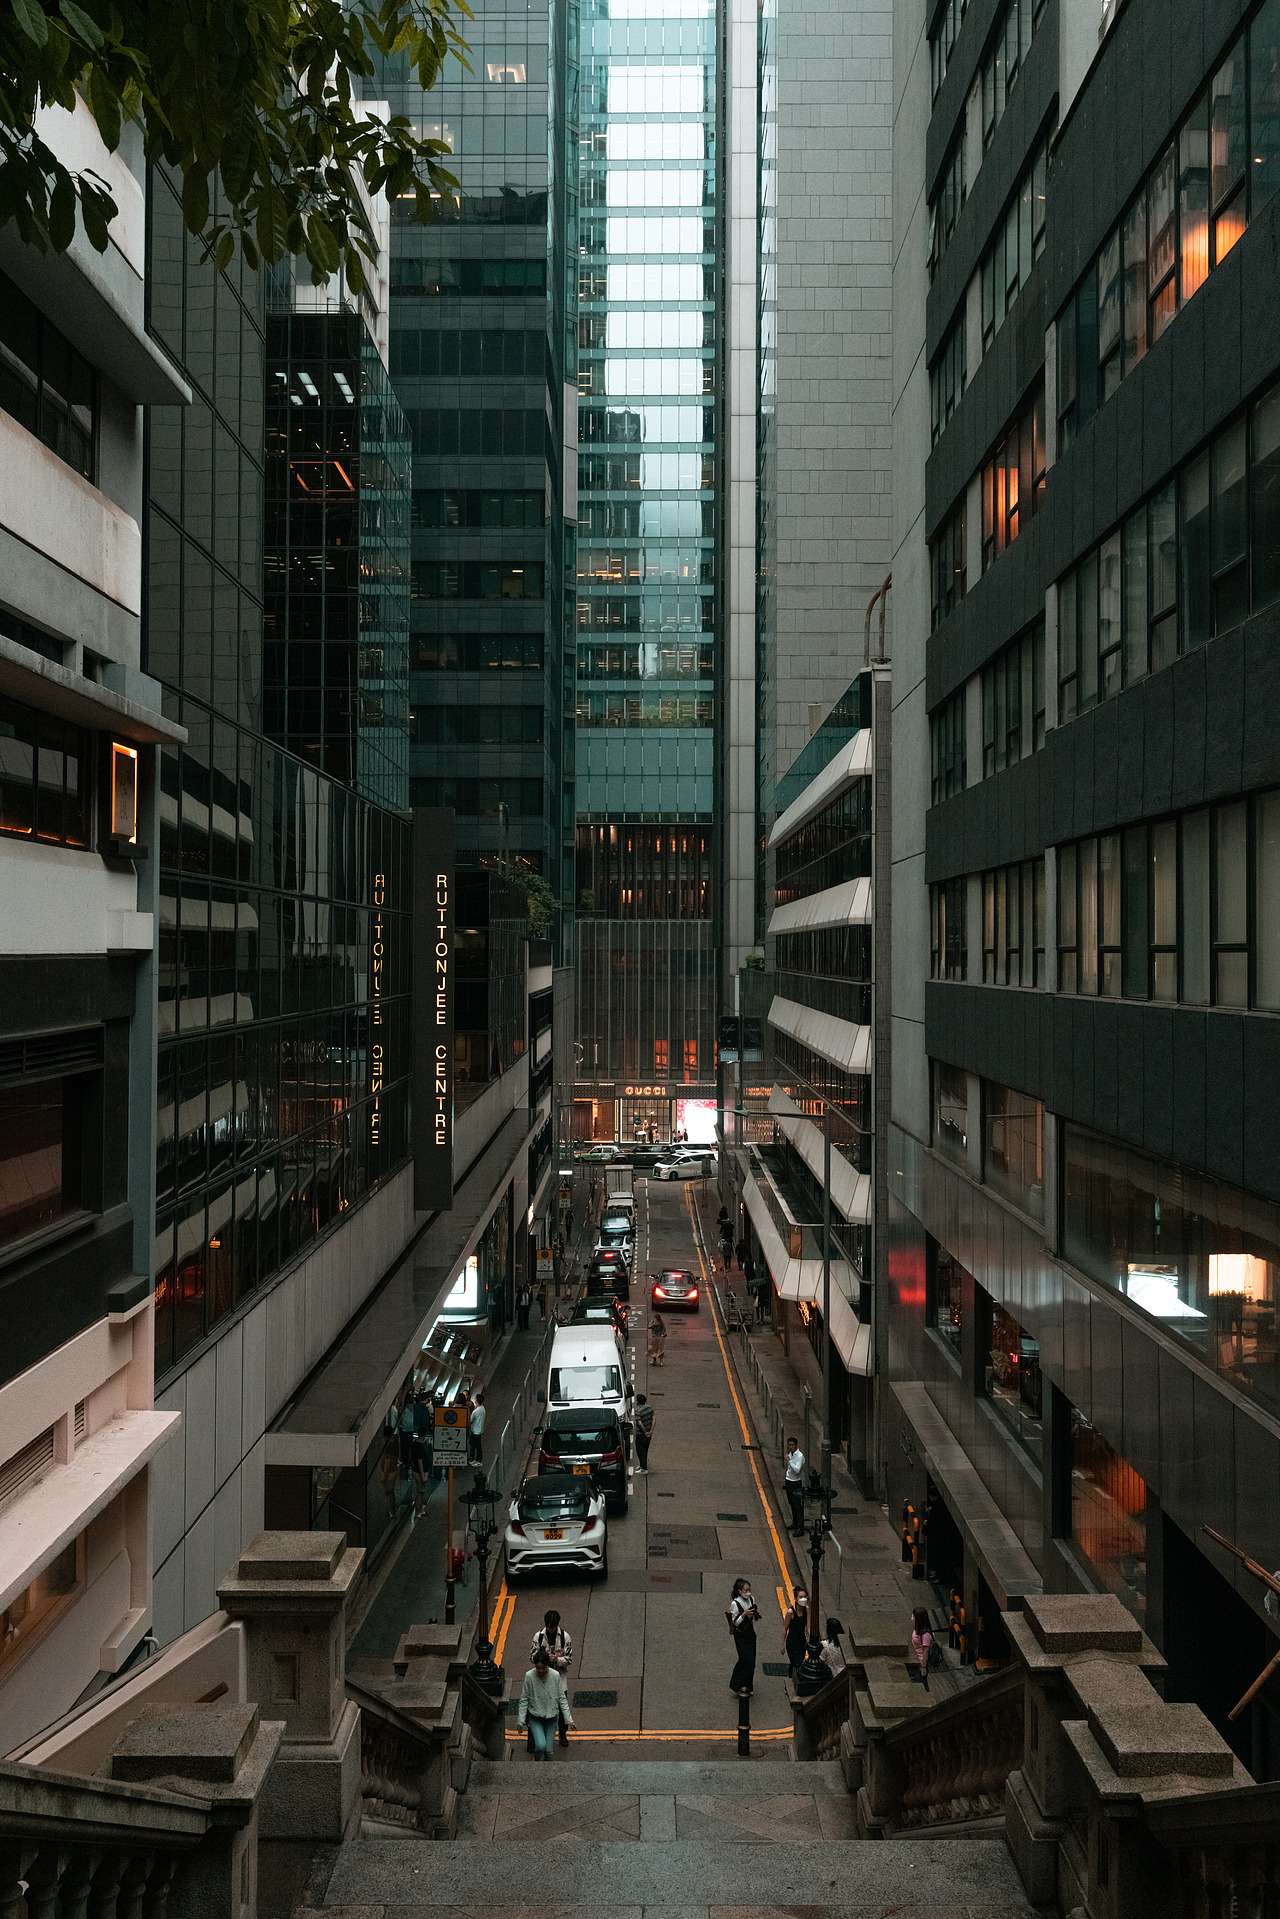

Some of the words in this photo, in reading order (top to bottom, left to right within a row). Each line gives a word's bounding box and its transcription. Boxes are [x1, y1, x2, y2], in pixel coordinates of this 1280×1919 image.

[434, 873, 449, 1026] RUTTONJEE
[434, 1043, 448, 1146] CENTRE
[624, 1085, 667, 1096] GUCCI
[455, 1429, 461, 1437] 7
[455, 1441, 461, 1449] 7
